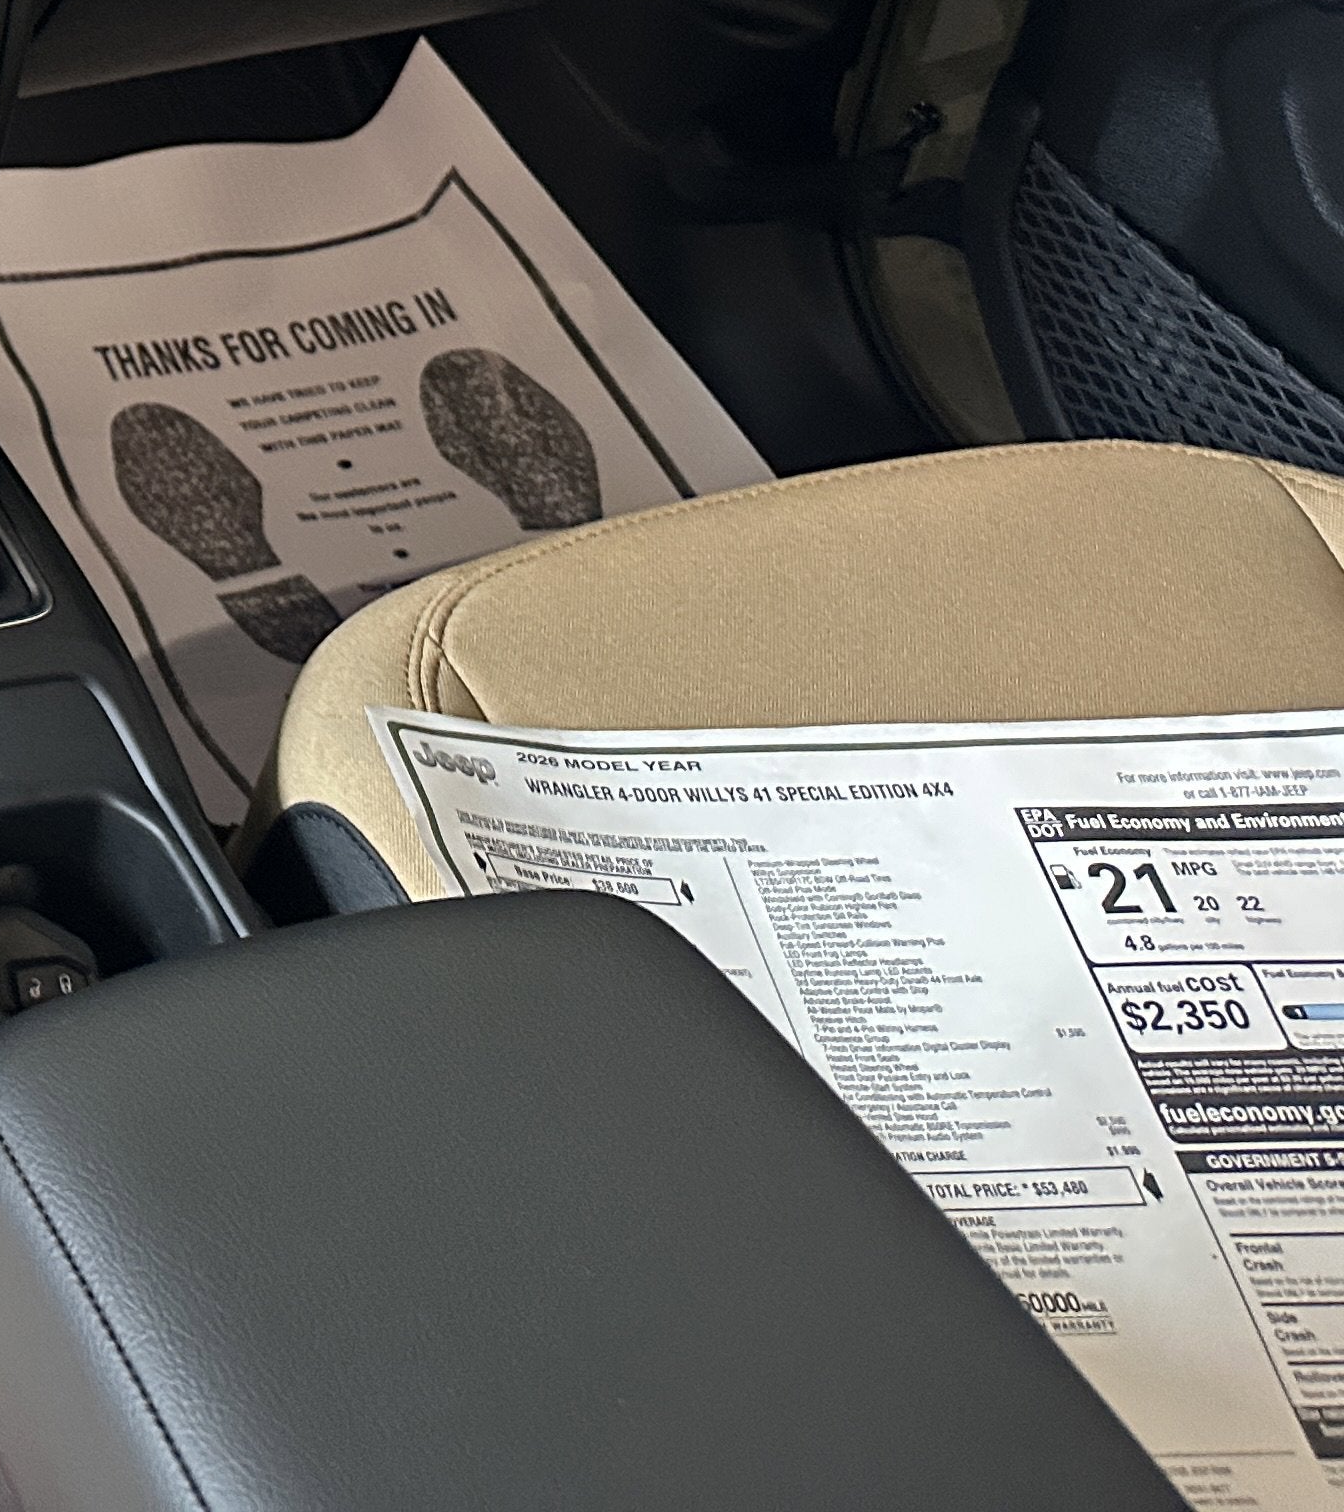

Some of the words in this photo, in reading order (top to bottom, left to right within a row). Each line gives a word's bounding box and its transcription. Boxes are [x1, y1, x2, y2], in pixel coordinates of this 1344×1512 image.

[93, 334, 222, 383] THANKS
[219, 325, 292, 368] FOR
[287, 299, 419, 356] COMING
[414, 286, 461, 329] IN
[413, 741, 497, 785] Jeep
[515, 751, 560, 768] 2026
[564, 758, 640, 773] MODEL
[643, 760, 703, 773] YEAR
[524, 776, 614, 802] WRANGLER
[617, 787, 681, 804] 4-DOOR
[684, 786, 749, 804] WILLYS
[753, 786, 772, 803] 41
[776, 784, 848, 802] SPECIAL
[850, 782, 919, 801] EDITION
[922, 780, 955, 798] 4X4
[1020, 808, 1058, 823] EPA
[1065, 813, 1107, 830] Fuel
[1111, 813, 1191, 833] Economy
[1194, 814, 1230, 830] and
[1028, 823, 1066, 839] DOT
[1073, 846, 1098, 857] Fuel
[1099, 846, 1152, 858] Economy
[513, 863, 541, 881] Base
[1087, 862, 1178, 914] 21
[1171, 861, 1218, 876] MPG
[1193, 895, 1220, 912] 20
[1236, 895, 1265, 912] 22
[1124, 934, 1156, 952] 4.8
[1107, 981, 1156, 995] Annual
[1157, 980, 1185, 994] fuel
[1185, 972, 1246, 993] cost
[1121, 998, 1251, 1036] $2,350
[1205, 1152, 1321, 1170] GOVERNMENT
[926, 1183, 972, 1200] TOTAL
[974, 1181, 1021, 1198] PRICE:
[1205, 1178, 1255, 1192] Overall
[1254, 1176, 1305, 1191] Vehicle
[1235, 1241, 1283, 1255] Frontal
[1242, 1258, 1284, 1273] Crash
[1266, 1310, 1298, 1325] Side
[1273, 1328, 1316, 1342] Crash
